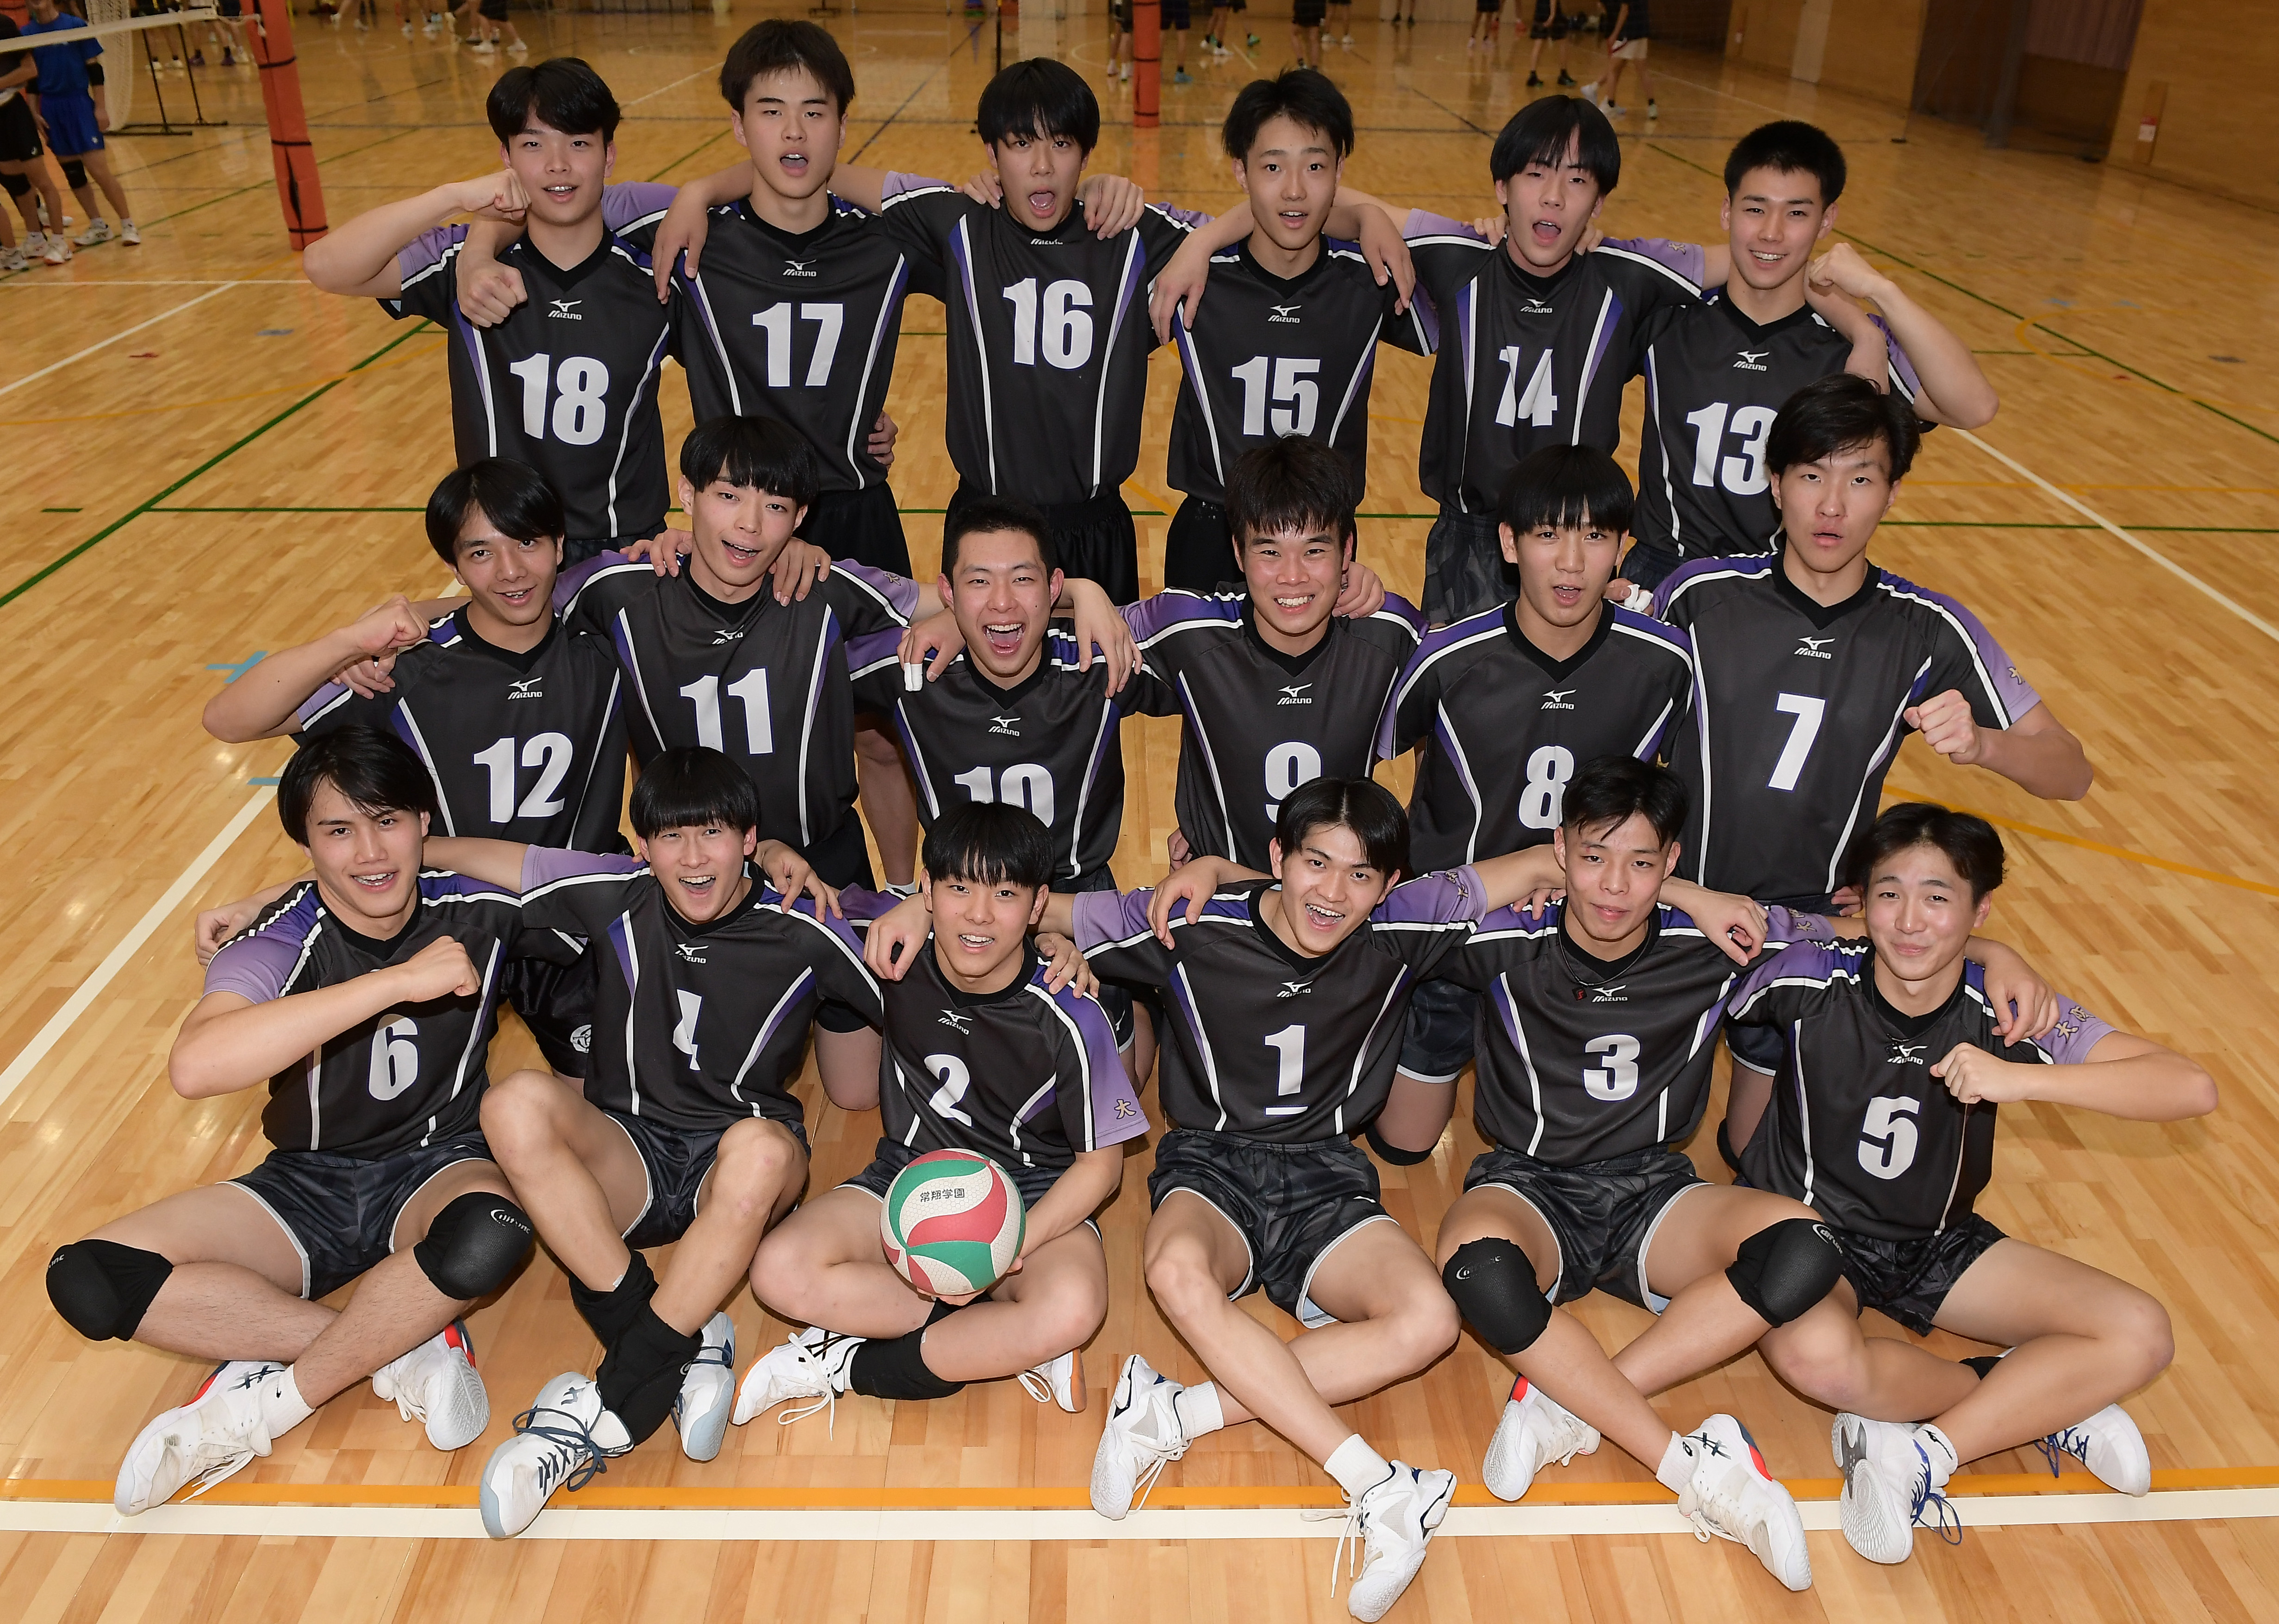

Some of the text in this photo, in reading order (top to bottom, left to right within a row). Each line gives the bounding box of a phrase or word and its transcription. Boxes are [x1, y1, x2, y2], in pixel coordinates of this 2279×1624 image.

[549, 311, 582, 320] MIZUNO
[753, 303, 843, 387] 17
[1003, 279, 1093, 369] 16
[511, 354, 609, 445] 18
[1233, 357, 1320, 438] 15
[1496, 347, 1557, 427] 14
[1734, 361, 1767, 372] MIZUNO
[1686, 402, 1778, 495] 13
[1795, 647, 1831, 660] MIZUNO
[508, 691, 542, 700] MIZUNO
[681, 669, 773, 754] 11
[989, 726, 1020, 737] MIZUNO
[1278, 697, 1312, 705] MIZUNO
[1542, 702, 1575, 710] MIZUNO
[474, 733, 573, 823] 12
[1769, 694, 1826, 791] 7
[955, 764, 1054, 828] 10
[1266, 742, 1321, 823] 9
[1519, 746, 1574, 828] 8
[368, 1014, 418, 1101] 6
[938, 1018, 970, 1035] MIZUNO
[1265, 1025, 1305, 1096] 1
[925, 1055, 972, 1127] 2
[1584, 1035, 1640, 1101] 3
[1859, 1097, 1920, 1180] 5
[920, 1188, 965, 1202] 常翔学園
